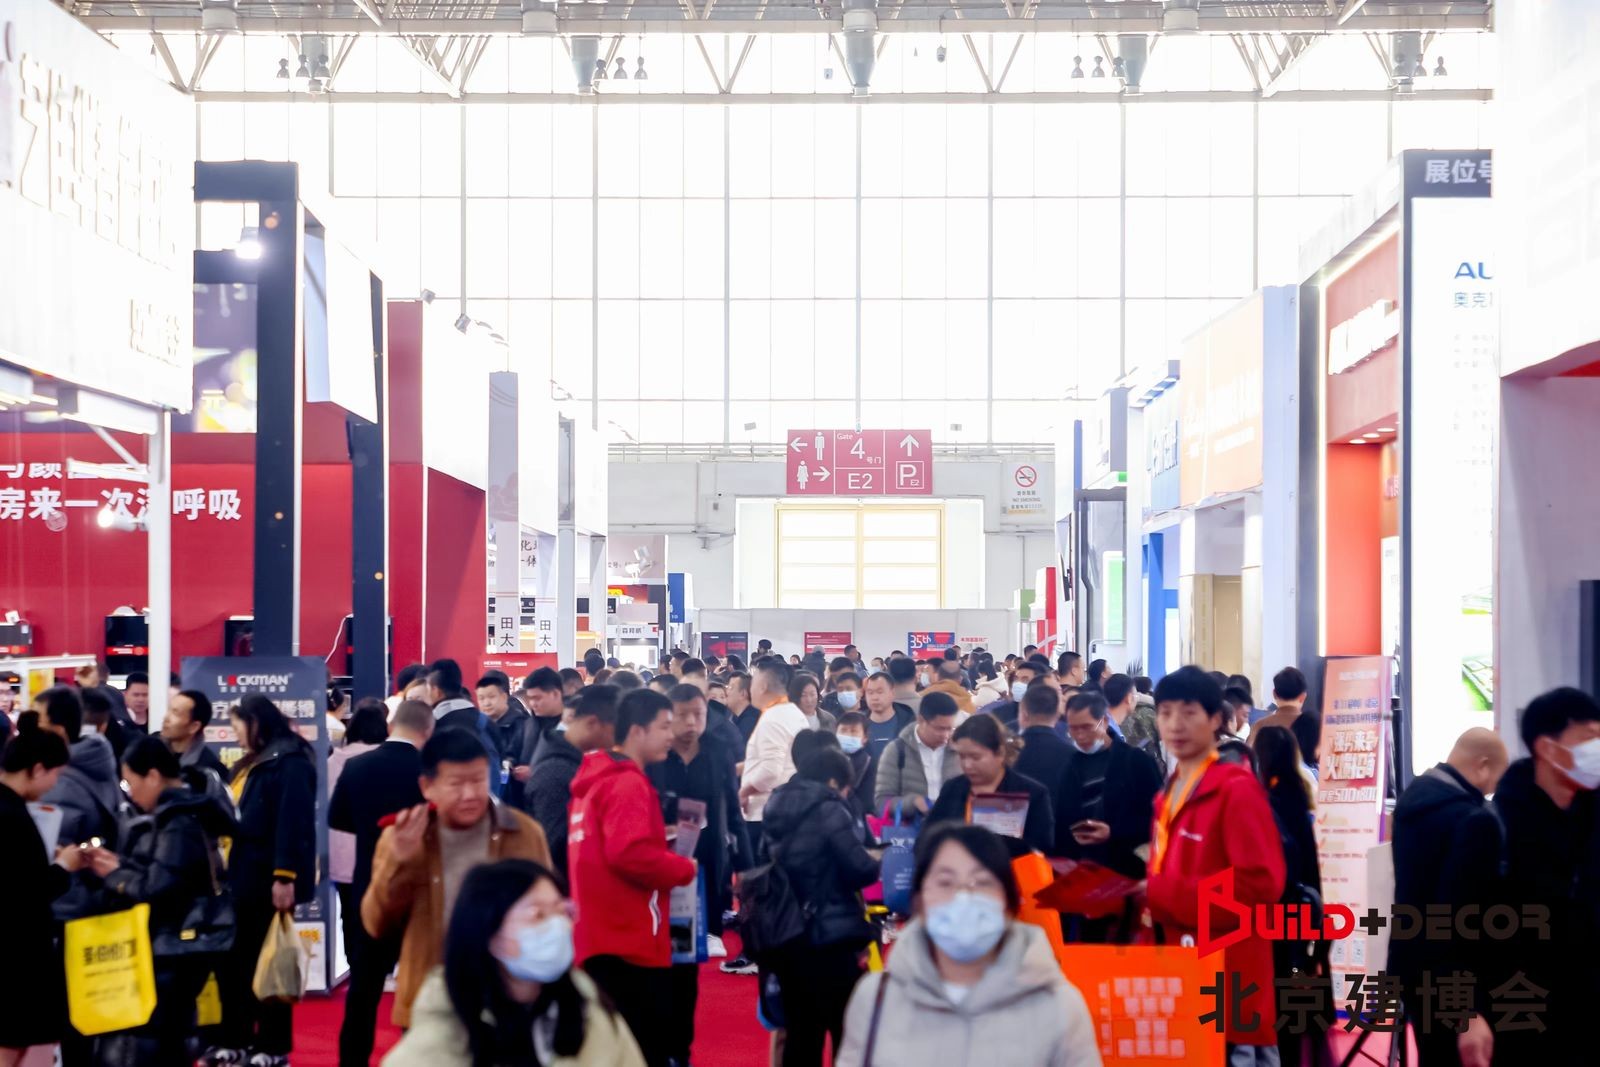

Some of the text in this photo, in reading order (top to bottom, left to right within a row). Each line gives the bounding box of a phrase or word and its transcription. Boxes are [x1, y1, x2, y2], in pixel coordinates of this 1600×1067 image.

[1454, 291, 1493, 308] 奥克
[850, 438, 866, 459] 4
[848, 473, 873, 489] E2
[900, 464, 917, 486] P
[910, 635, 932, 649] 35th
[217, 675, 289, 686] LOCKMAN
